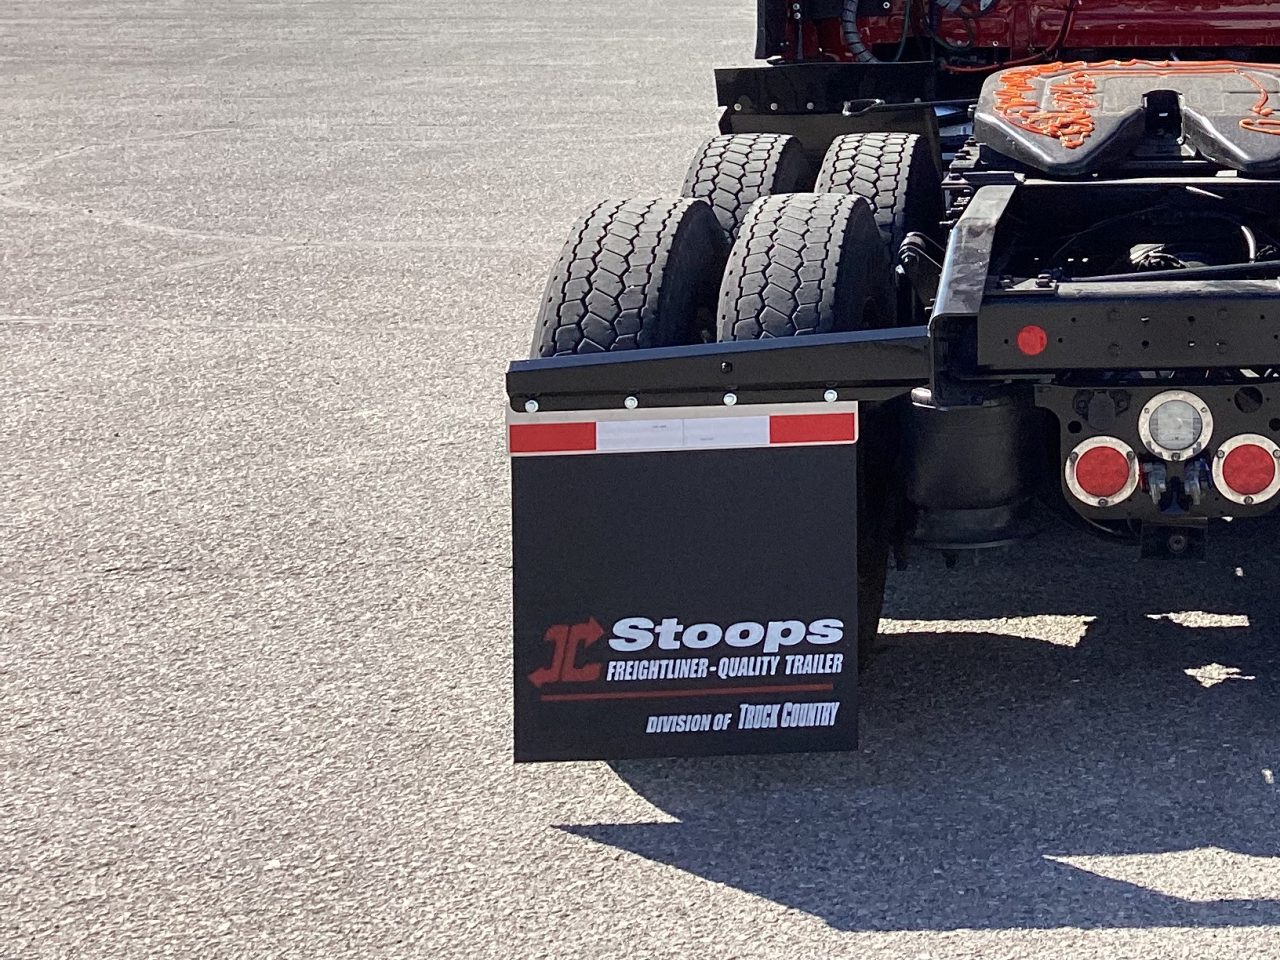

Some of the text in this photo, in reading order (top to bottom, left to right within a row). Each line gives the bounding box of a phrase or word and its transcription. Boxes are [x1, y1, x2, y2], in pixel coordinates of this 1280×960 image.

[608, 616, 844, 653] Stoops
[785, 653, 844, 675] TRAILER
[645, 701, 840, 734] DIVISION OF TRUCK COUNTRY
